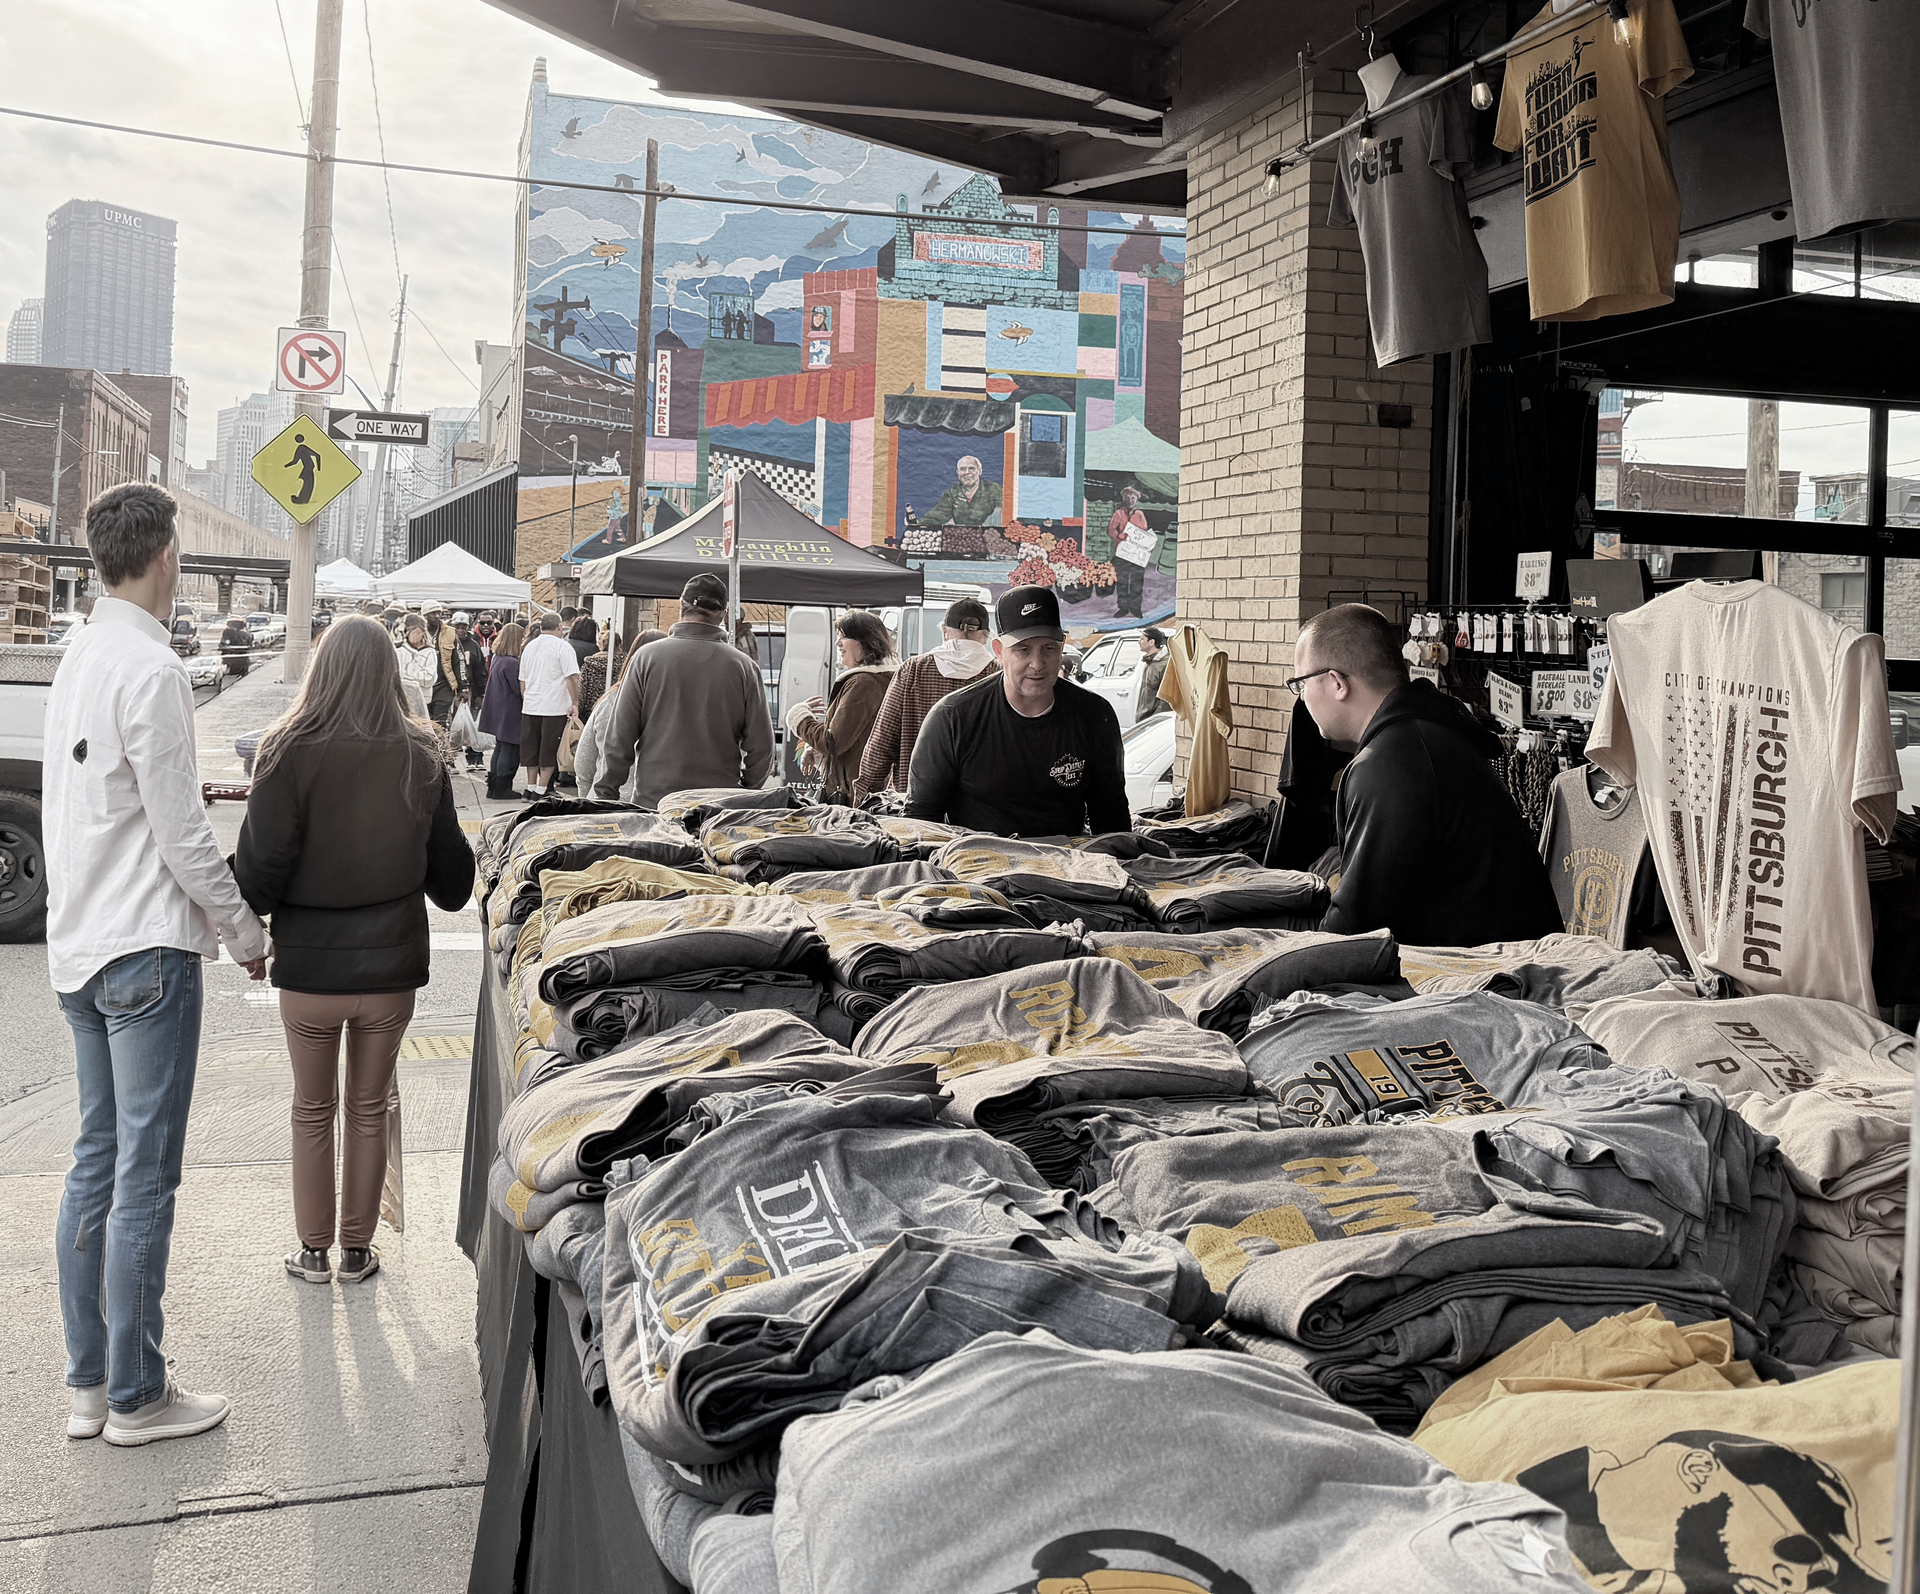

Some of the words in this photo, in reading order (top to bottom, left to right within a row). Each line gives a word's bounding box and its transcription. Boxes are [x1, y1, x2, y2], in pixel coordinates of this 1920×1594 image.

[1525, 63, 1573, 118] TURN
[1536, 77, 1598, 133] DOWN
[1525, 121, 1564, 166] FOR
[1350, 136, 1403, 197] PGH
[1525, 125, 1598, 197] WATT
[104, 209, 142, 228] UPMC
[931, 241, 1026, 264] HERMANOWSKI
[659, 353, 669, 394] PARK
[356, 420, 383, 434] ONE
[390, 422, 418, 436] WAY
[657, 397, 668, 434] HERE
[698, 549, 834, 565] Ditillery
[1520, 559, 1548, 569] EARRINGS
[1491, 675, 1504, 687] BLACK
[1509, 684, 1521, 695] GOLD
[1536, 681, 1566, 689] NECKLACE
[1537, 673, 1566, 681] BASEBALL
[1665, 672, 1689, 688] CITY
[1697, 675, 1711, 691] OF
[1716, 679, 1790, 706] CHAMPIONS
[1743, 706, 1789, 977] PITTSBURGH
